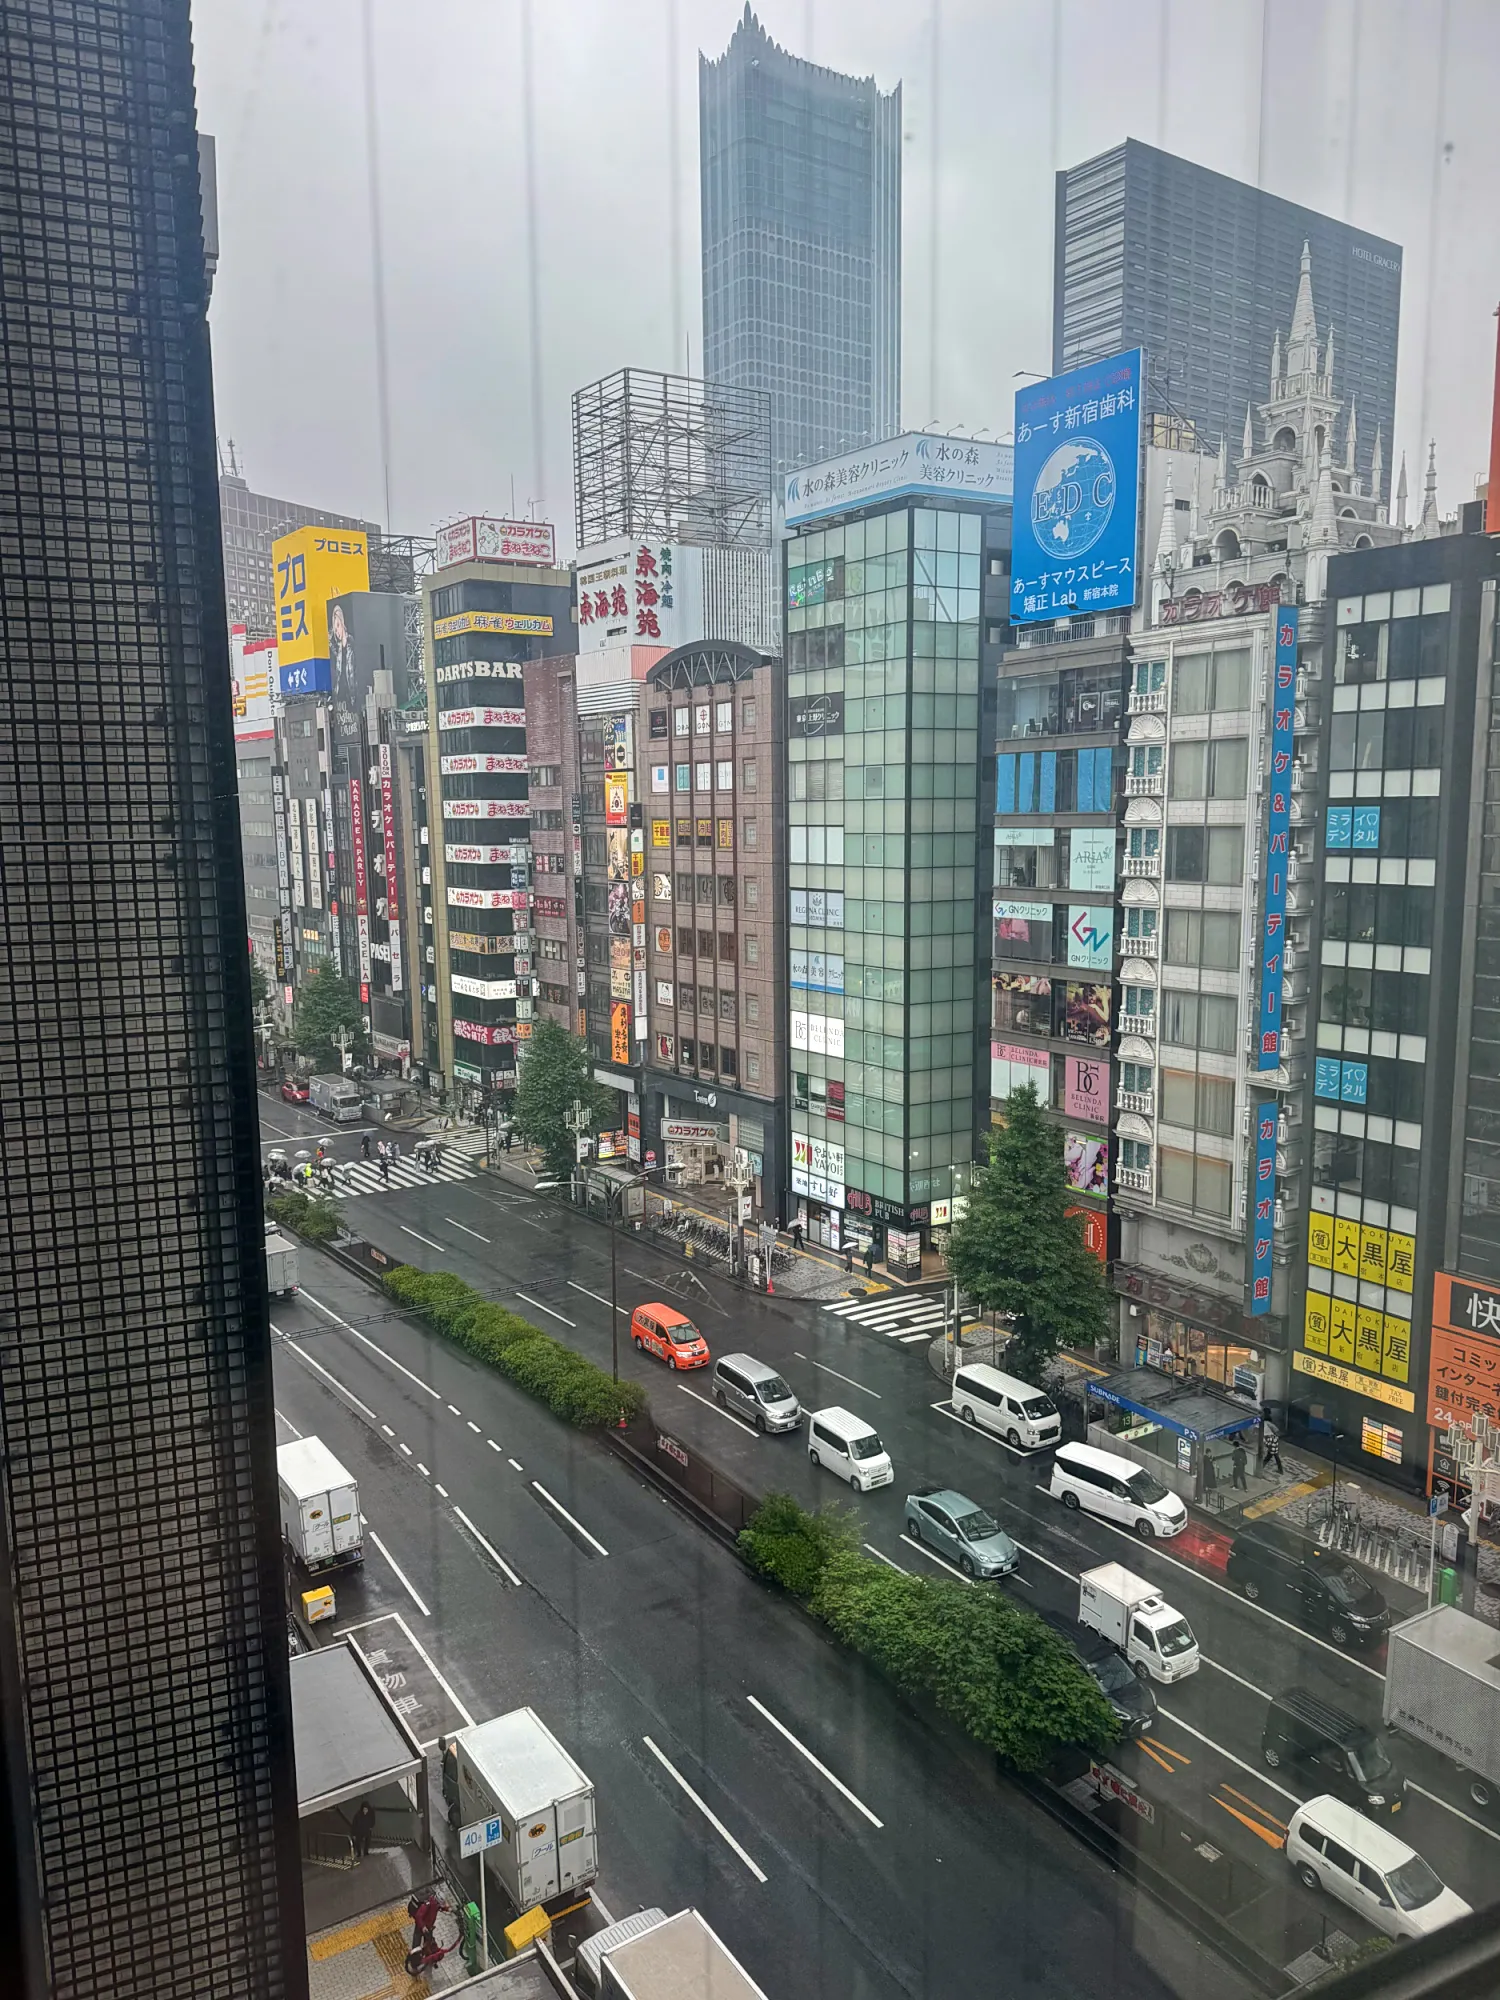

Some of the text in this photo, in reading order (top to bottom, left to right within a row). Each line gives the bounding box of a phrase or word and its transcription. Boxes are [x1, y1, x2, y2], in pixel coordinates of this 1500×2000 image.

[1352, 246, 1401, 273] HOTEL GRACERY
[1017, 385, 1136, 444] あーす新宿歯科
[935, 442, 980, 466] 水の森
[802, 448, 910, 498] 水の森美容クリニック
[919, 463, 995, 488] 美容クリニック
[1032, 471, 1114, 525] EDC
[507, 525, 543, 540] カラオケ
[313, 537, 365, 556] プロミス
[500, 539, 552, 559] まねきねこ
[277, 553, 306, 600] プロ
[1013, 555, 1132, 595] あーすマウスピース
[635, 544, 662, 639] 東海苑
[1023, 582, 1119, 615] 矯正 Lab 新宿本院
[579, 582, 629, 626] 東海苑
[1162, 585, 1281, 624] カラオケ館
[280, 599, 309, 642] ミス
[473, 614, 552, 632] 麻雀 ウェルカム
[435, 660, 524, 684] DARTS BAR
[450, 711, 472, 725] カラオケ
[453, 756, 474, 769] カラオケ
[455, 802, 476, 816] カラオケ
[1328, 812, 1367, 827] ミライ
[351, 779, 361, 835] KARAOKE
[356, 848, 365, 887] PARTY
[1327, 829, 1378, 843] デンタル
[457, 848, 478, 861] カラオケ
[459, 892, 480, 905] カラオケ
[1008, 904, 1048, 917] GNクリニック
[359, 919, 370, 981] PASELA
[391, 928, 400, 984] パセラ
[1070, 953, 1109, 966] GNクリニック
[1010, 1046, 1039, 1058] BELINDA
[1317, 1063, 1353, 1081] ミライ
[1316, 1077, 1366, 1098] デンタル
[1070, 1092, 1102, 1107] BELINDA
[1073, 1101, 1099, 1114] CLINIC
[674, 1126, 709, 1138] カラオケ
[813, 1144, 844, 1164] やよい軒
[847, 1188, 872, 1217] HUB
[874, 1199, 905, 1217] BRITISH
[1253, 1118, 1275, 1299] カラオケ館
[874, 1208, 890, 1221] PUB
[909, 1206, 929, 1221] HUB
[1338, 1221, 1412, 1248] DAIKOKUYA
[1336, 1234, 1413, 1278] 大黒屋
[1334, 1305, 1408, 1334] DAIKOKUYA
[1332, 1318, 1409, 1365] 大黒屋
[1317, 1362, 1350, 1384] 大黒屋
[1089, 1384, 1121, 1405] SUBNADE
[1387, 1395, 1404, 1406] FREE
[1389, 1388, 1403, 1398] TAX
[1121, 1415, 1132, 1427] 13
[489, 1821, 498, 1836] P
